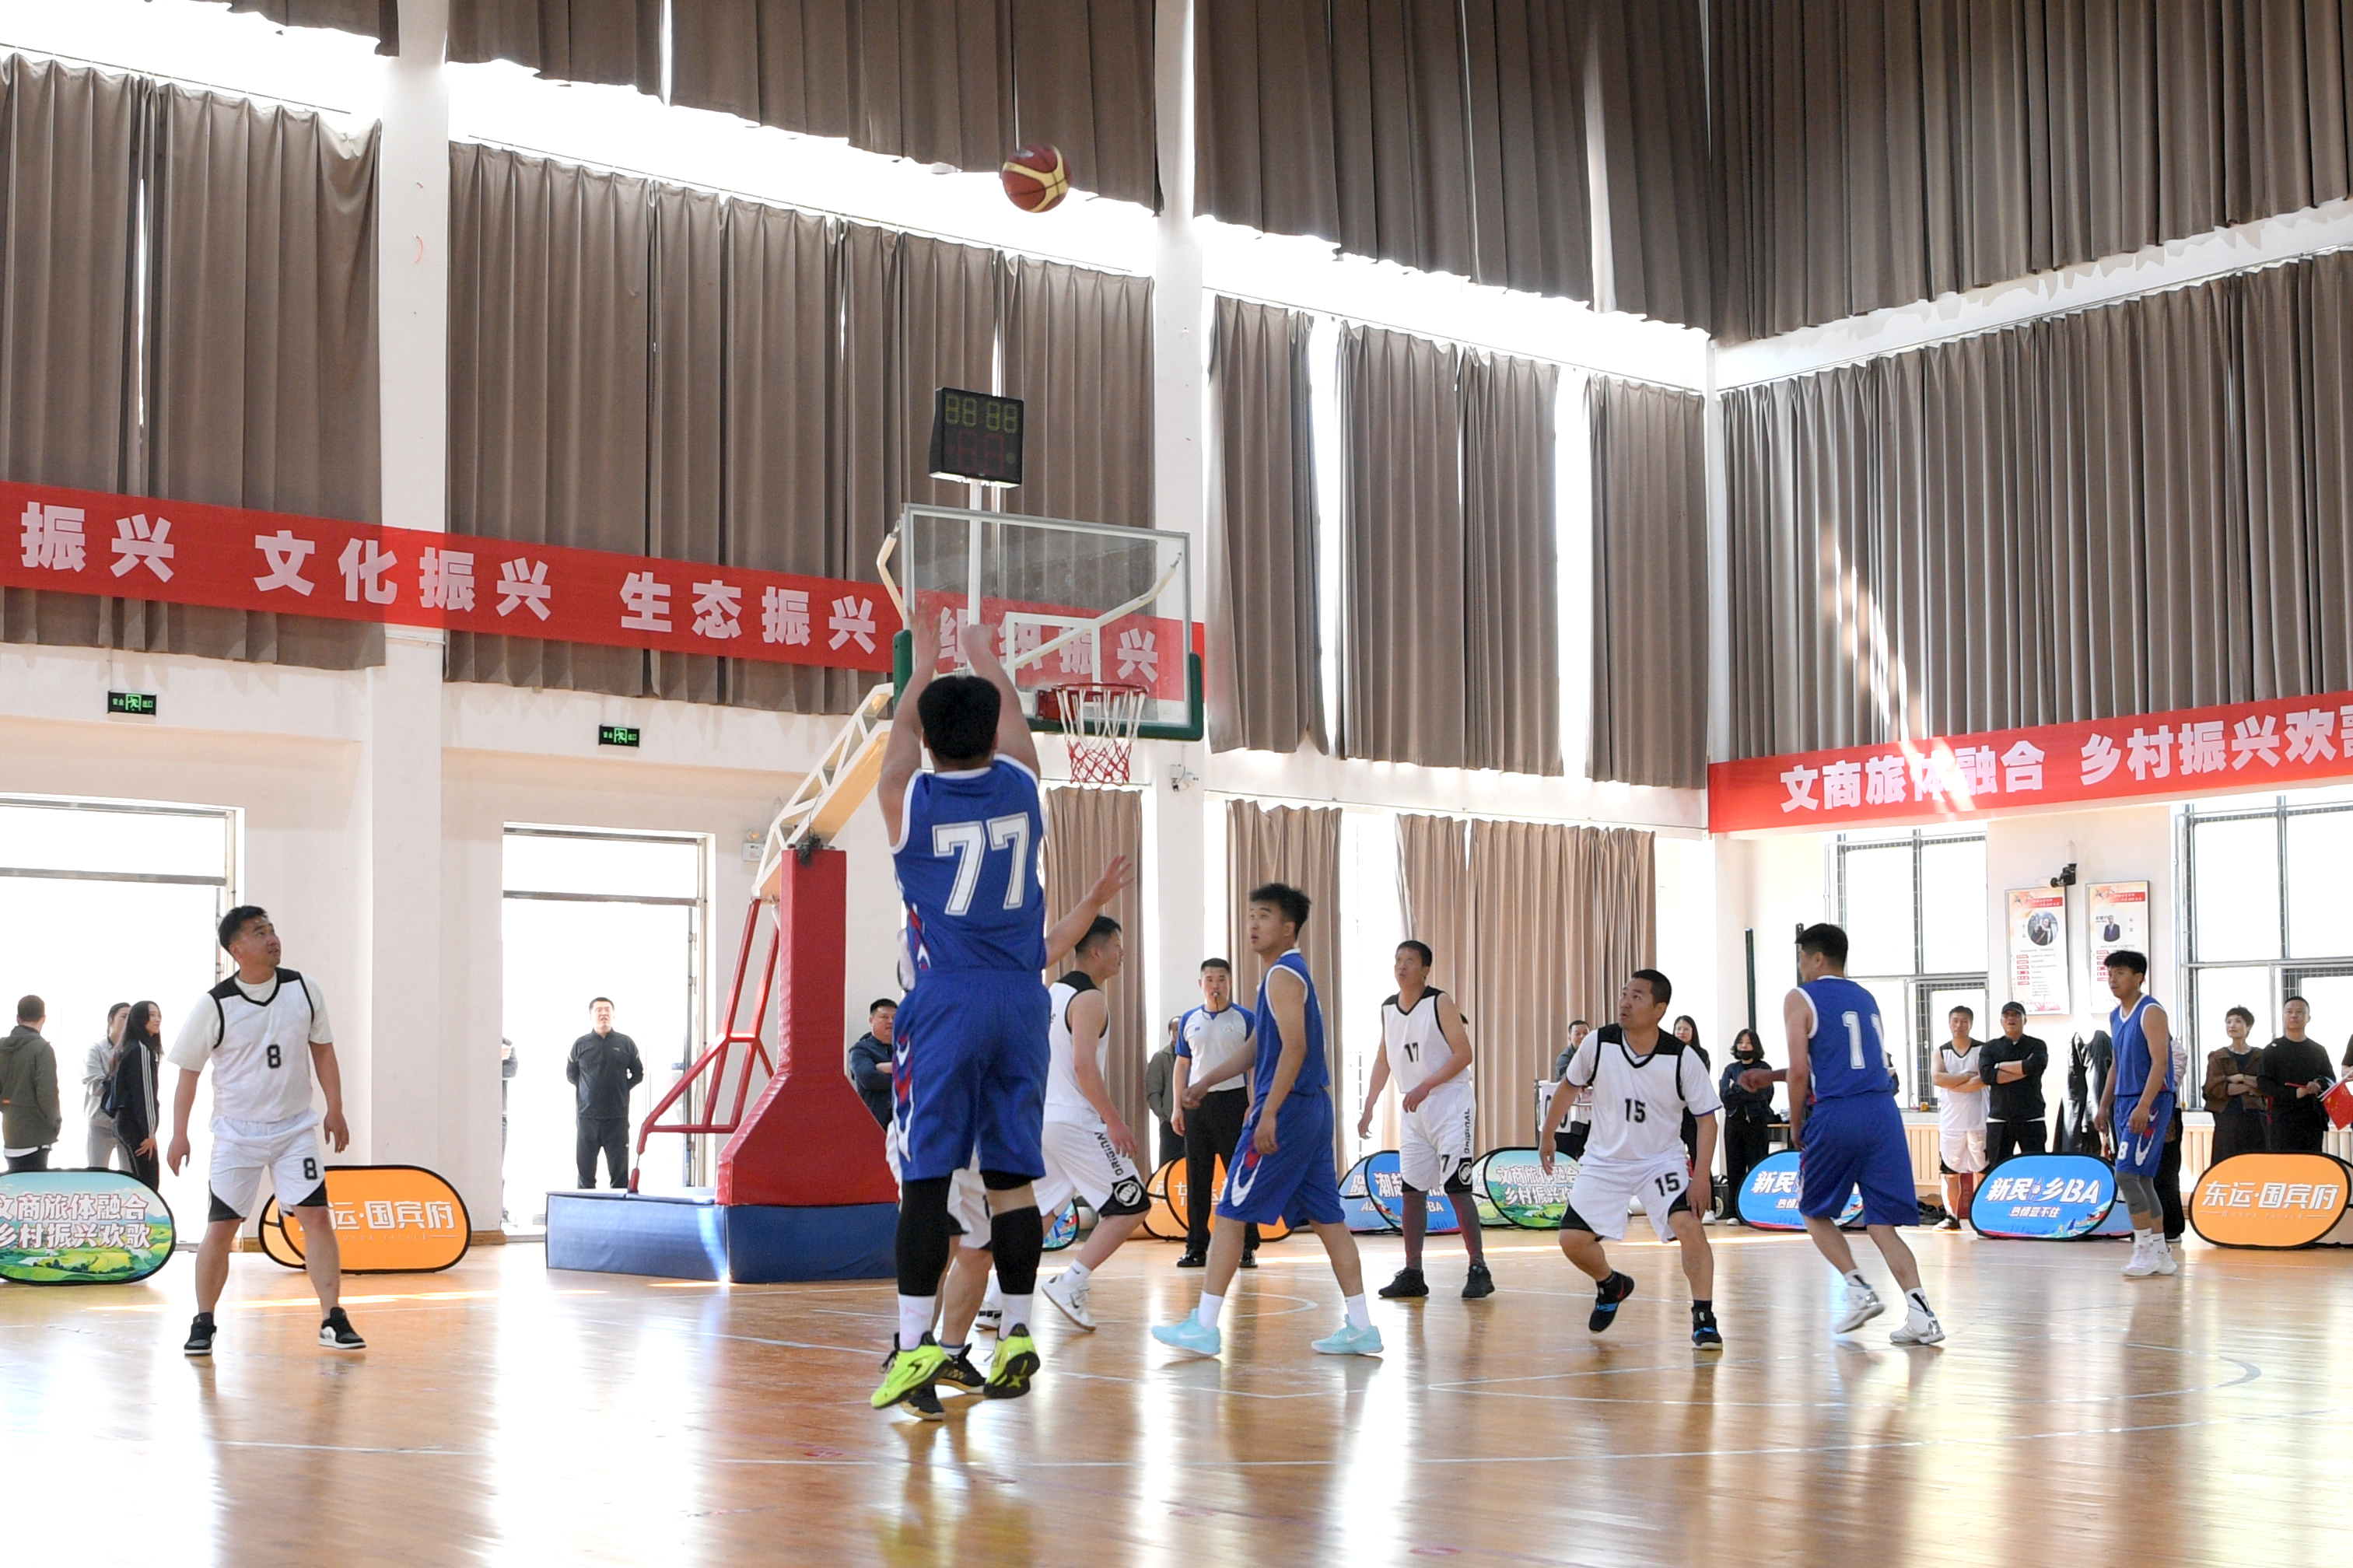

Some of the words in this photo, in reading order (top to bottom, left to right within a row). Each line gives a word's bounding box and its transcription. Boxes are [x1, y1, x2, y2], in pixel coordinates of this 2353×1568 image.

[21, 501, 174, 583] 振兴
[254, 530, 551, 621] 文化振兴
[619, 571, 877, 654] 生态振兴
[1780, 740, 2046, 814] 文商旅体融合
[2080, 705, 2353, 786] 乡村振兴欢
[932, 810, 1030, 917] 77
[1403, 1041, 1419, 1063] 17
[1841, 1010, 1889, 1070] 11
[267, 1044, 282, 1069] 8
[1625, 1097, 1646, 1123] 15
[303, 1157, 317, 1181] 8
[1438, 1153, 1450, 1174] 7
[1654, 1172, 1680, 1197] 15
[2201, 1180, 2340, 1210] 东运·国宾府
[0, 1193, 149, 1221] 文商旅体融合
[299, 1200, 455, 1230] 运·国宾府
[0, 1222, 152, 1249] 乡村振兴欢歌
